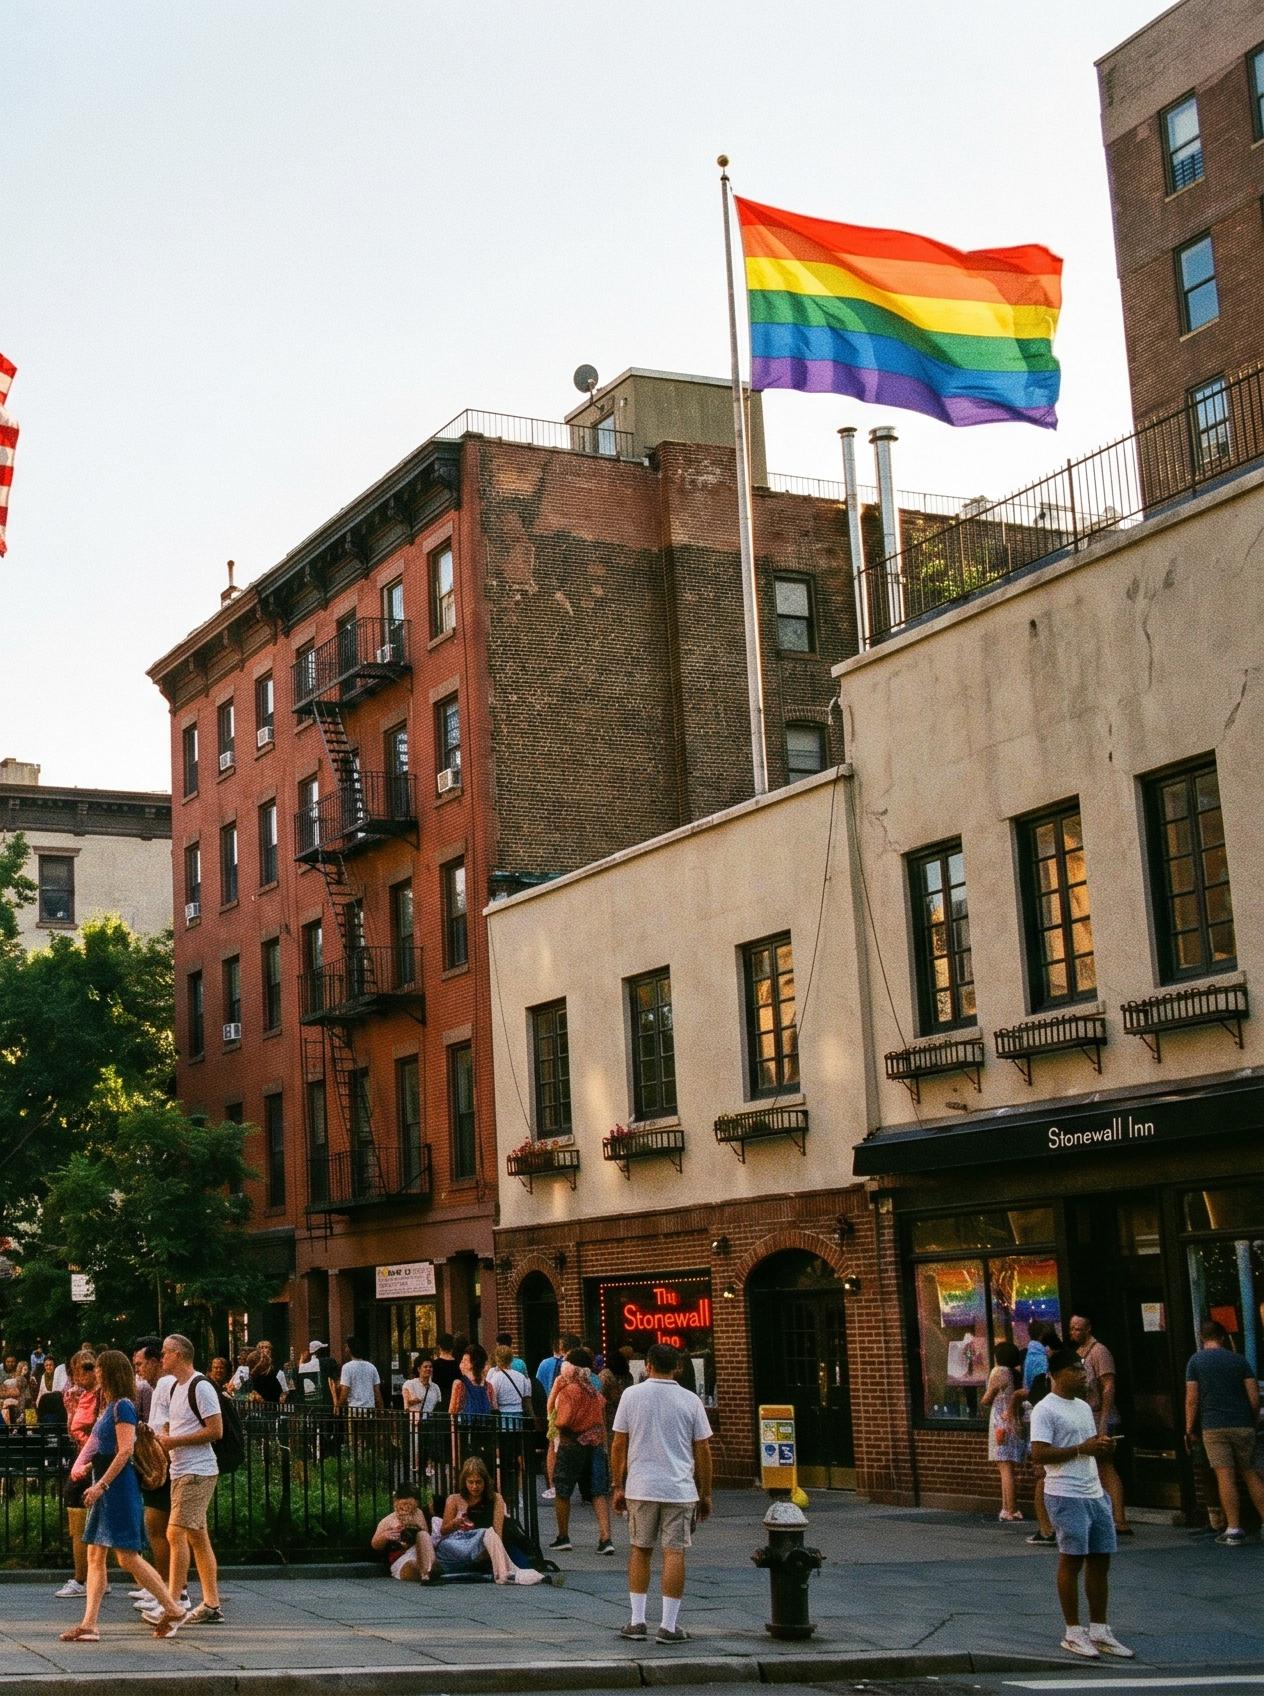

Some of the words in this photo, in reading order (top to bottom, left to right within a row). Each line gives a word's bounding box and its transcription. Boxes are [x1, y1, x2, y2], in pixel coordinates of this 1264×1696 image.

[1048, 1117, 1122, 1149] Stonewall
[1129, 1115, 1155, 1139] Inn
[623, 1298, 711, 1331] Stonewall
